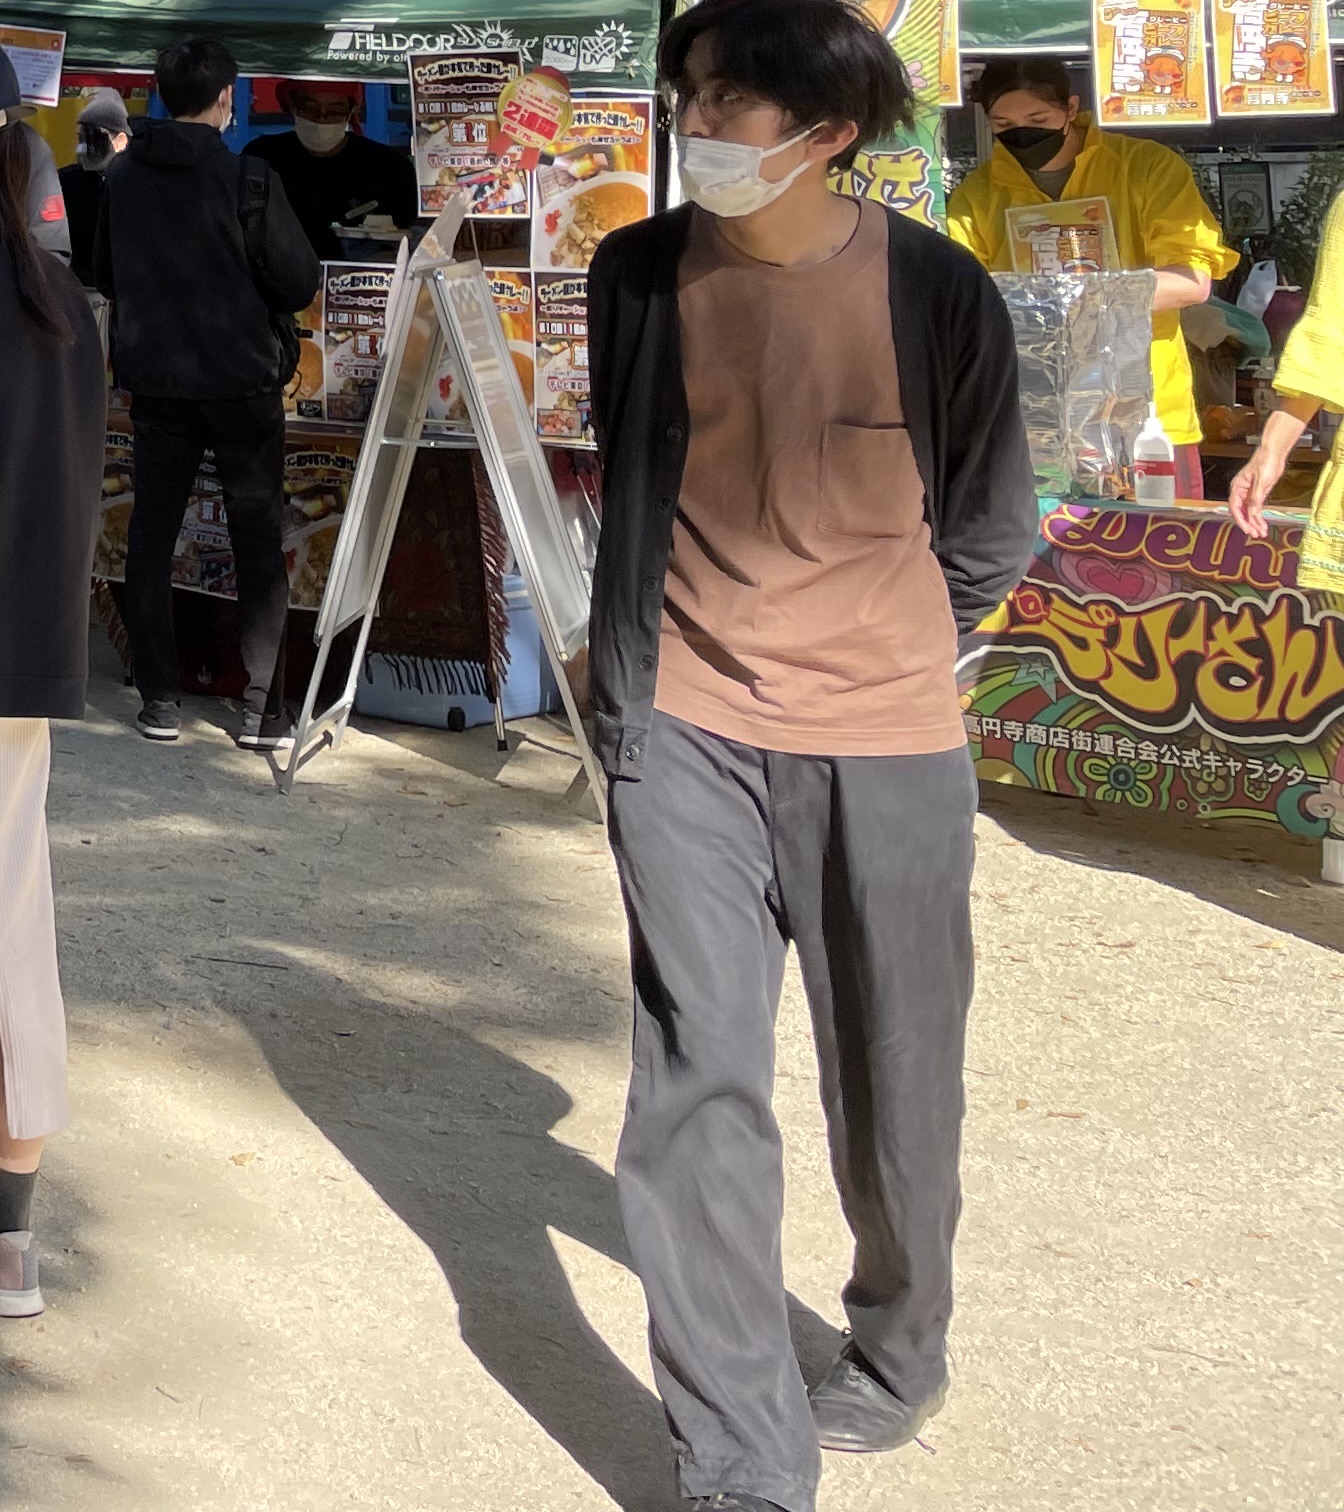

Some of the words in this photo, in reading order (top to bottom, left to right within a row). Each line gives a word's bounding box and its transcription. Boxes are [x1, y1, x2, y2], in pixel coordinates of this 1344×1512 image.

[1263, 11, 1308, 25] ビーフ
[1143, 24, 1186, 37] ビーフ
[1263, 24, 1307, 35] カレー
[355, 32, 455, 51] FIELDOOR
[1143, 36, 1185, 48] カレー
[327, 50, 371, 61] Powered
[376, 51, 390, 62] by
[583, 52, 605, 65] UV
[1248, 91, 1289, 105] 高円寺
[1127, 104, 1166, 116] 高円寺
[452, 122, 488, 144] 第1位
[980, 590, 1344, 723] デリーさん
[964, 714, 1329, 787] 高円寺商店街連合会公式キャラクター
